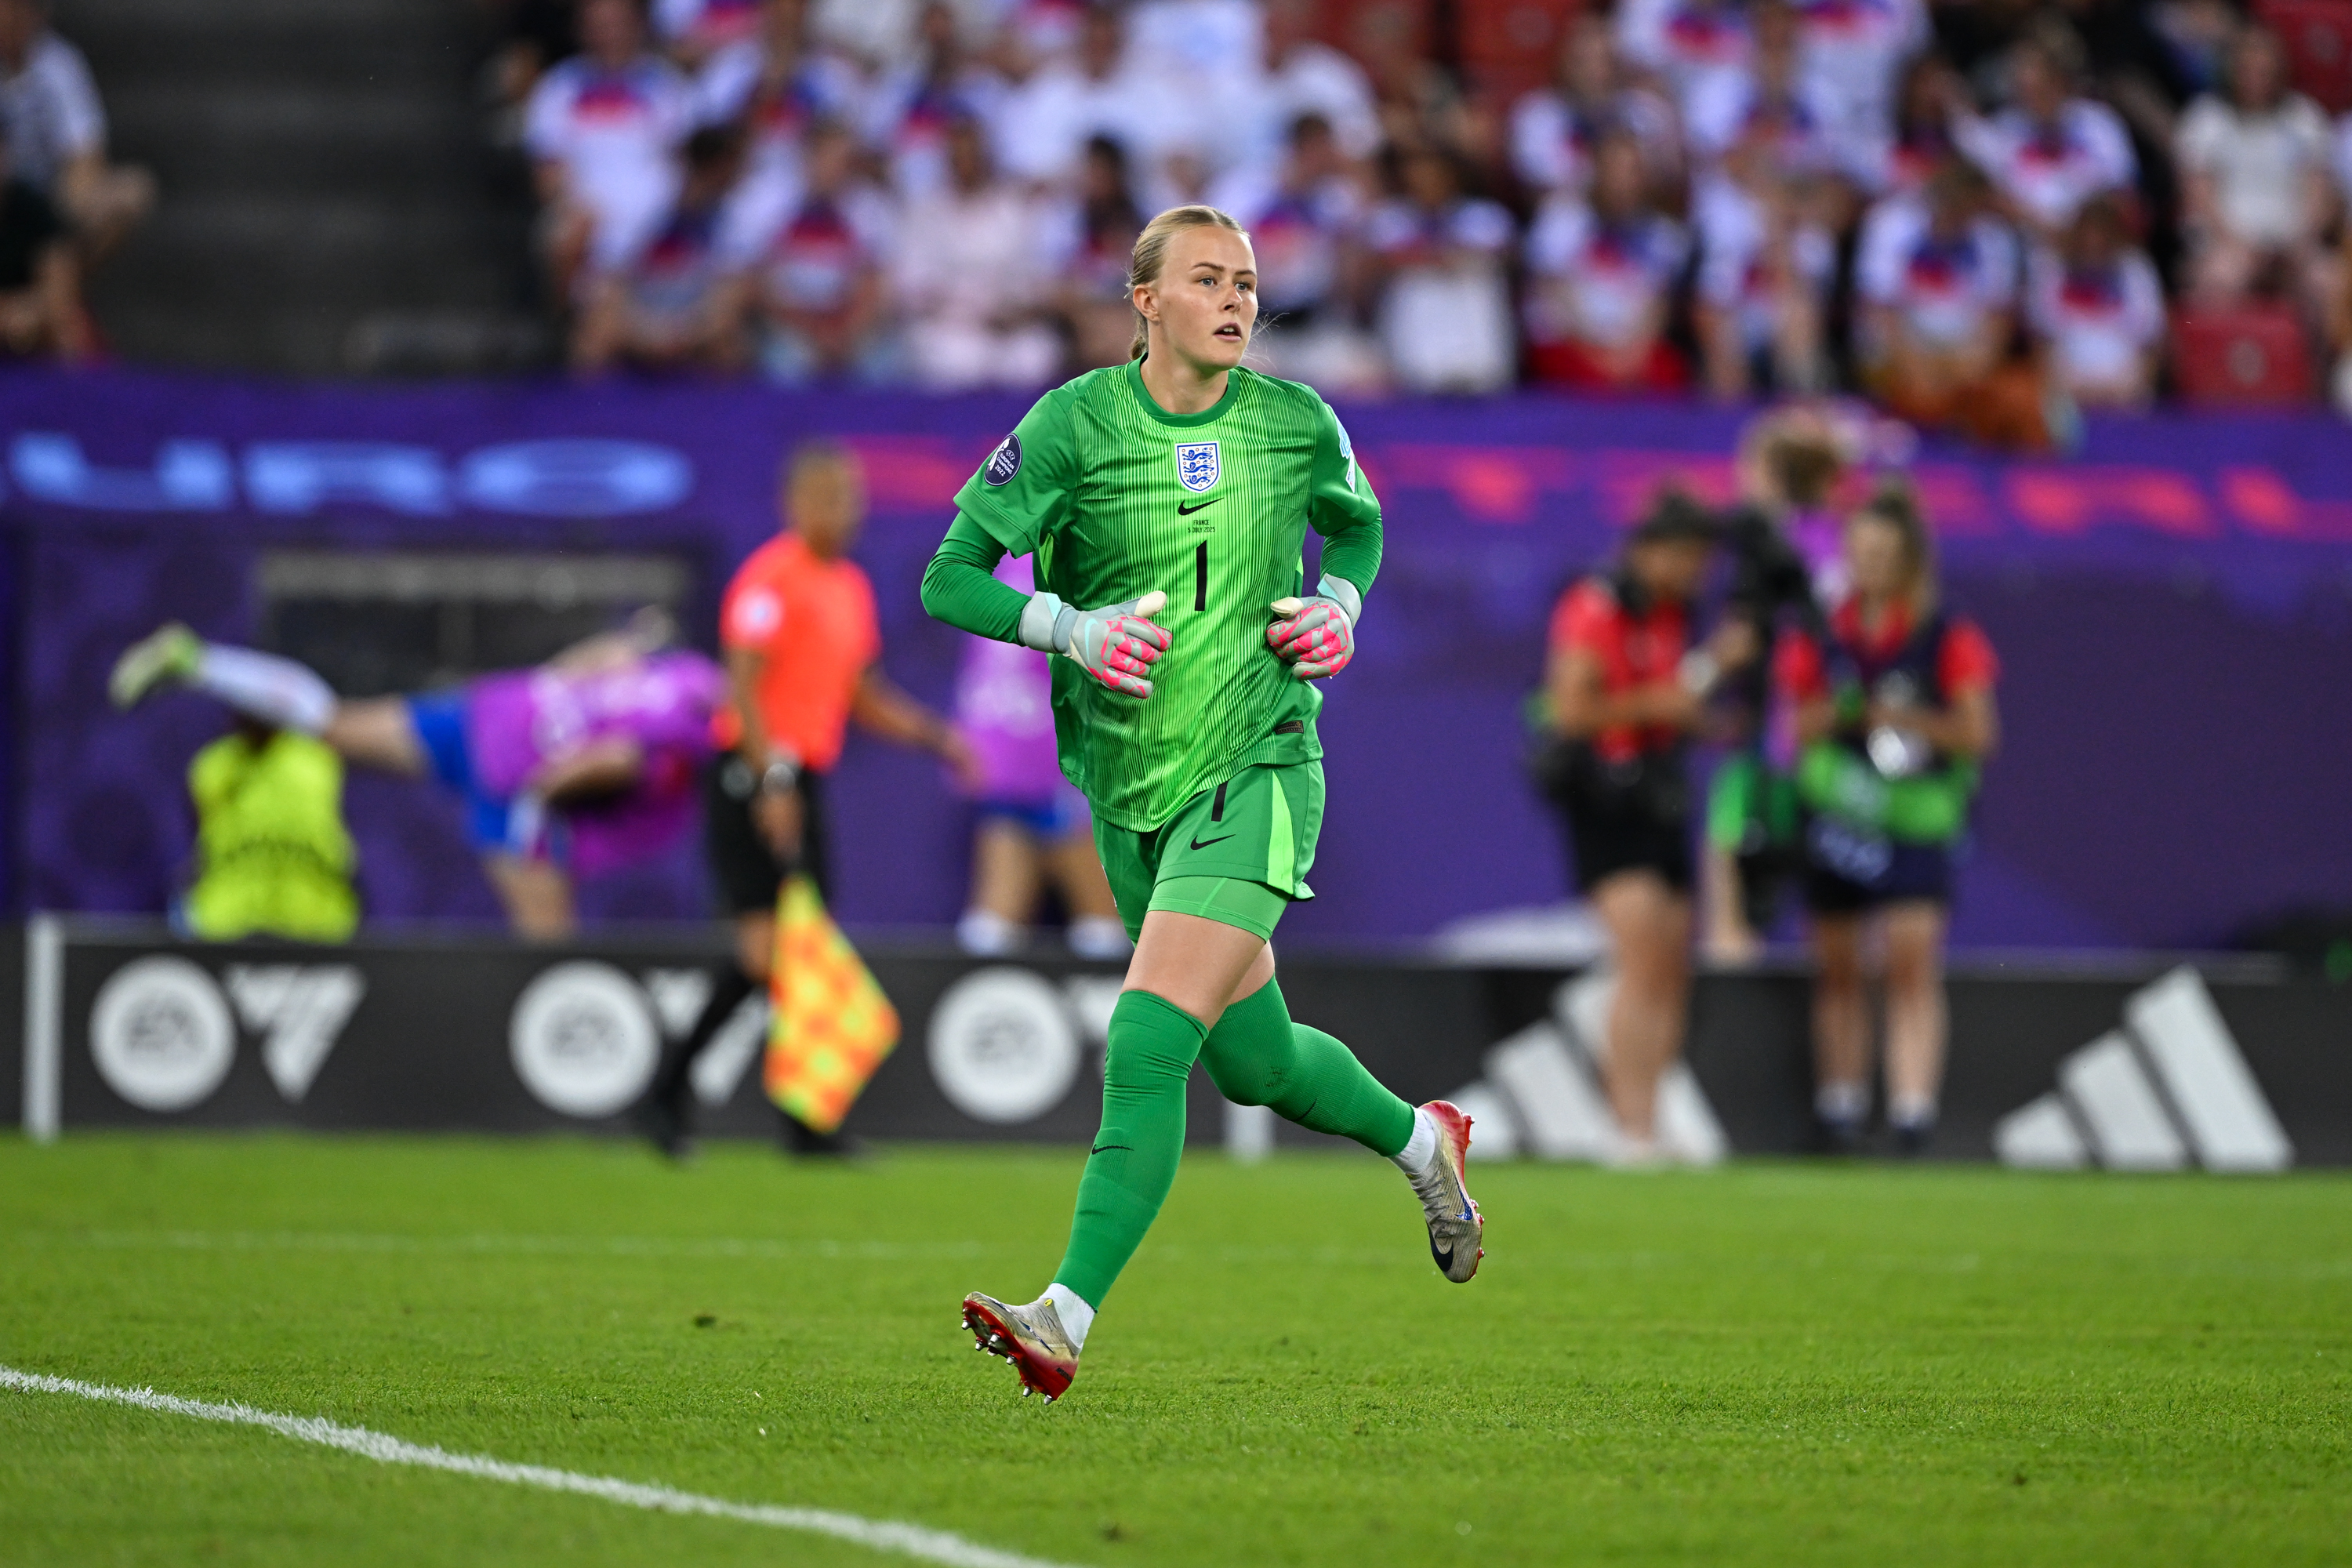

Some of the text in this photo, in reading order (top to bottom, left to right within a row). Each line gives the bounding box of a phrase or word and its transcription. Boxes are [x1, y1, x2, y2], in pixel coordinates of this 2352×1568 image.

[996, 456, 1012, 474] CHAMPIONS
[1000, 452, 1014, 469] EUROPEAN
[0, 433, 693, 516] URO
[995, 464, 1005, 477] 2022
[1195, 539, 1207, 612] 1
